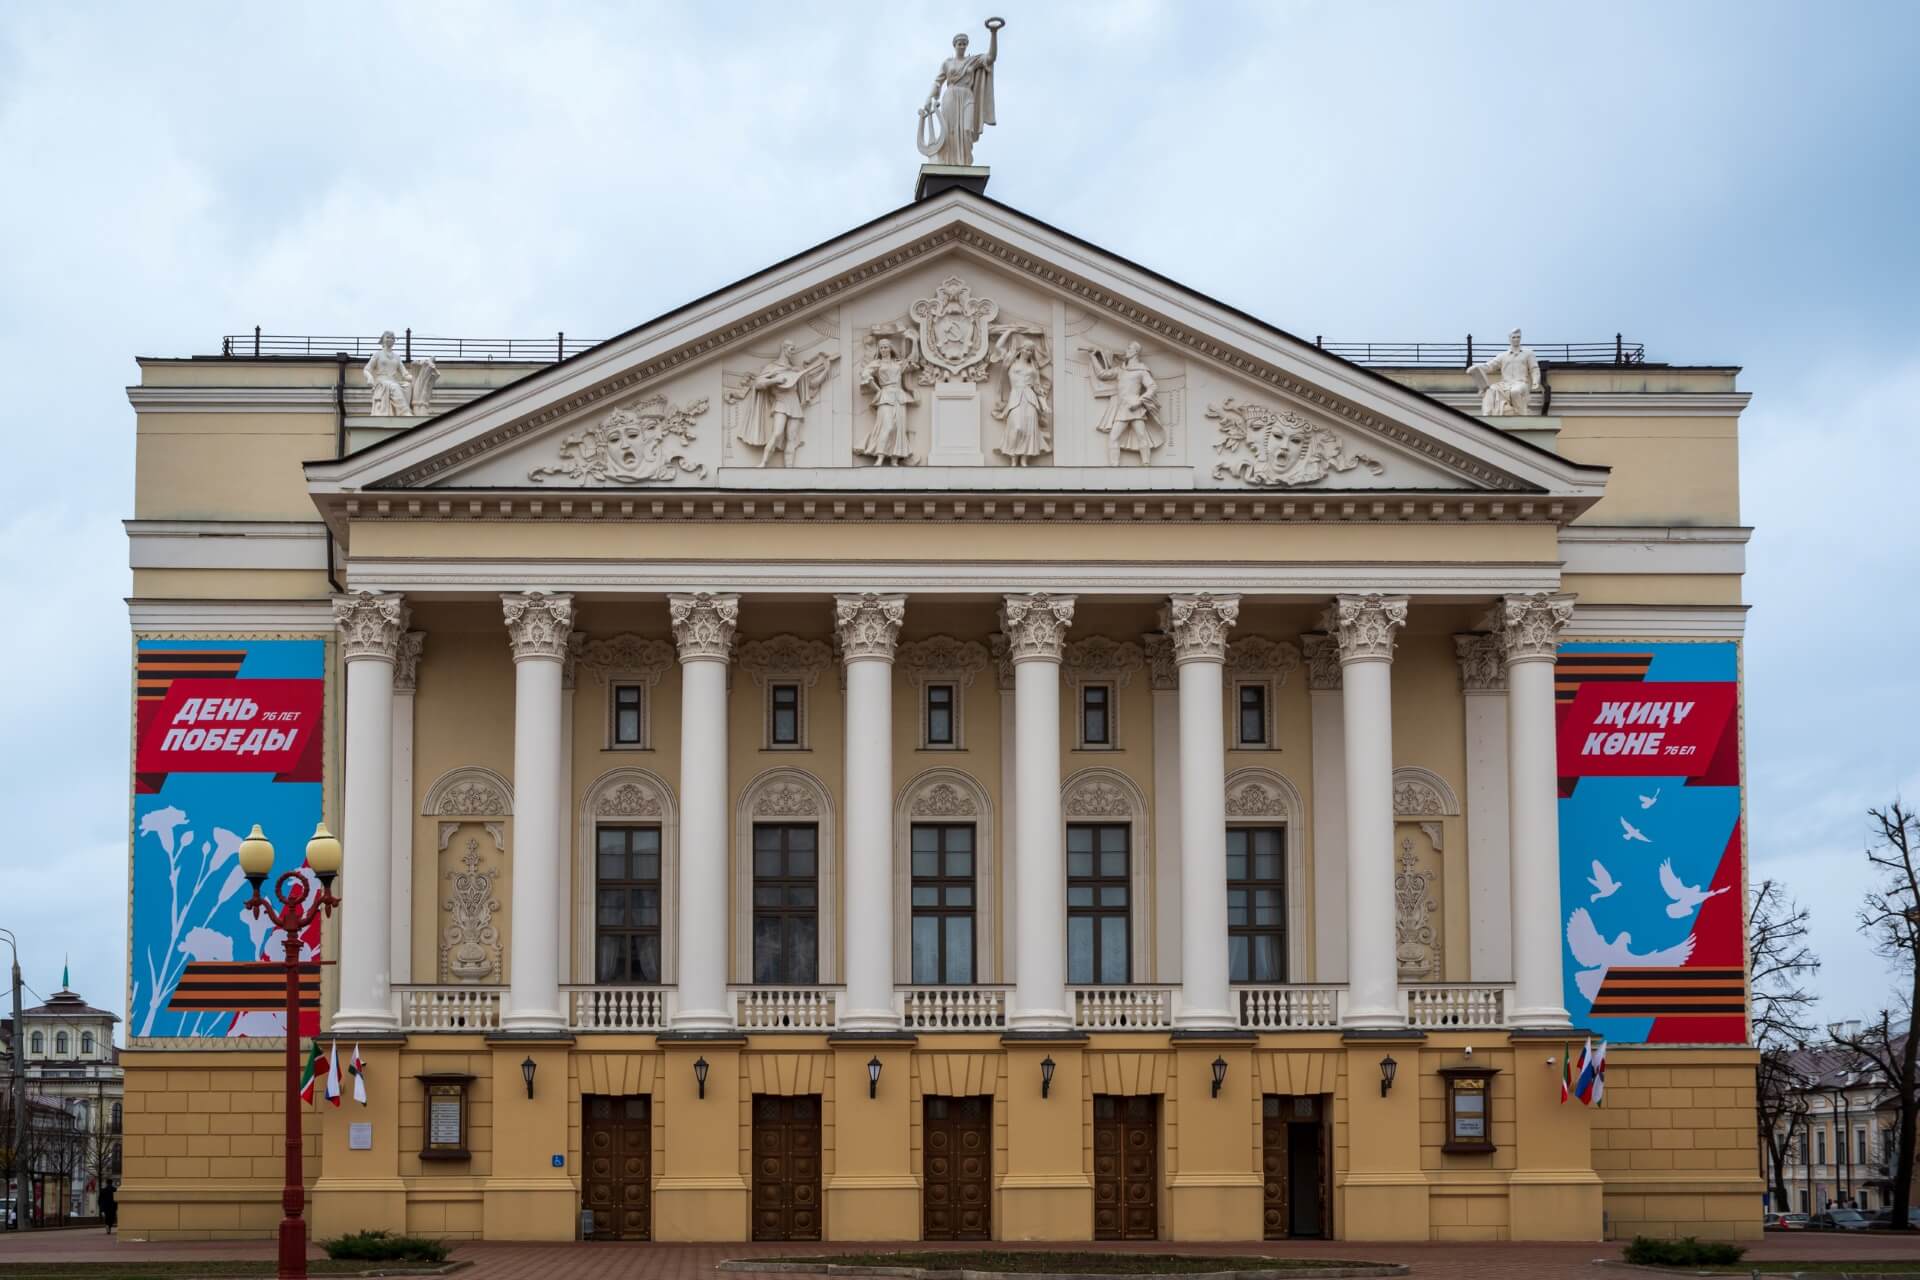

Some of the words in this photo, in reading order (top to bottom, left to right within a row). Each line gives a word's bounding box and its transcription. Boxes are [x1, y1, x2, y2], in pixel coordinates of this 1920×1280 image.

[172, 698, 259, 725] ДЕНЬ
[262, 712, 277, 721] 76
[278, 712, 301, 721] ЛЕТ
[160, 728, 298, 756] ПОБЕДЫ
[1581, 732, 1665, 755] КӨНЕ
[1664, 746, 1679, 755] 76
[1679, 746, 1696, 755] ЕЛ
